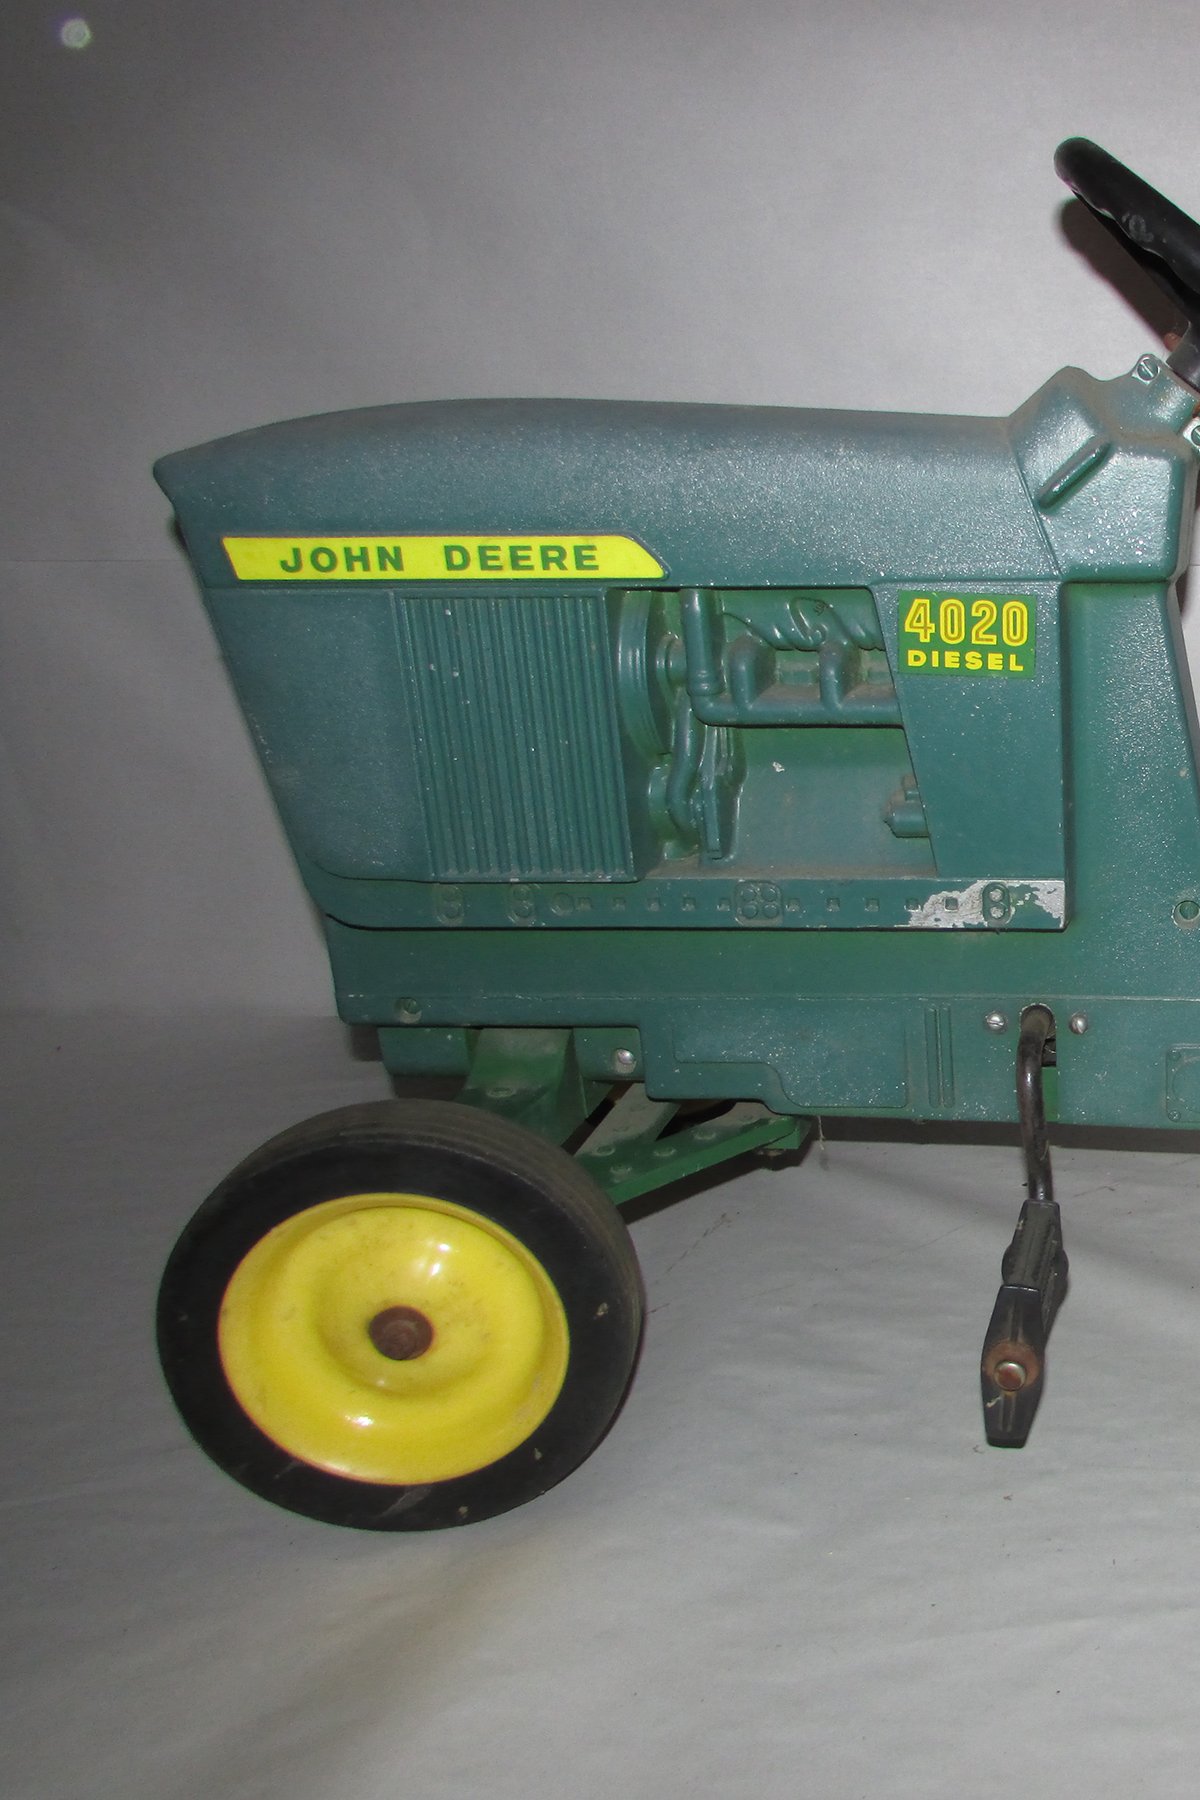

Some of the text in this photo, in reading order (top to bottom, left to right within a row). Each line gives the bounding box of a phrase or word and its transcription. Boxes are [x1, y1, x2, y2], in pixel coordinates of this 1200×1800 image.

[279, 544, 600, 573] JOHN DEERE
[904, 598, 1029, 647] 4020
[907, 649, 1025, 672] DIESEL
